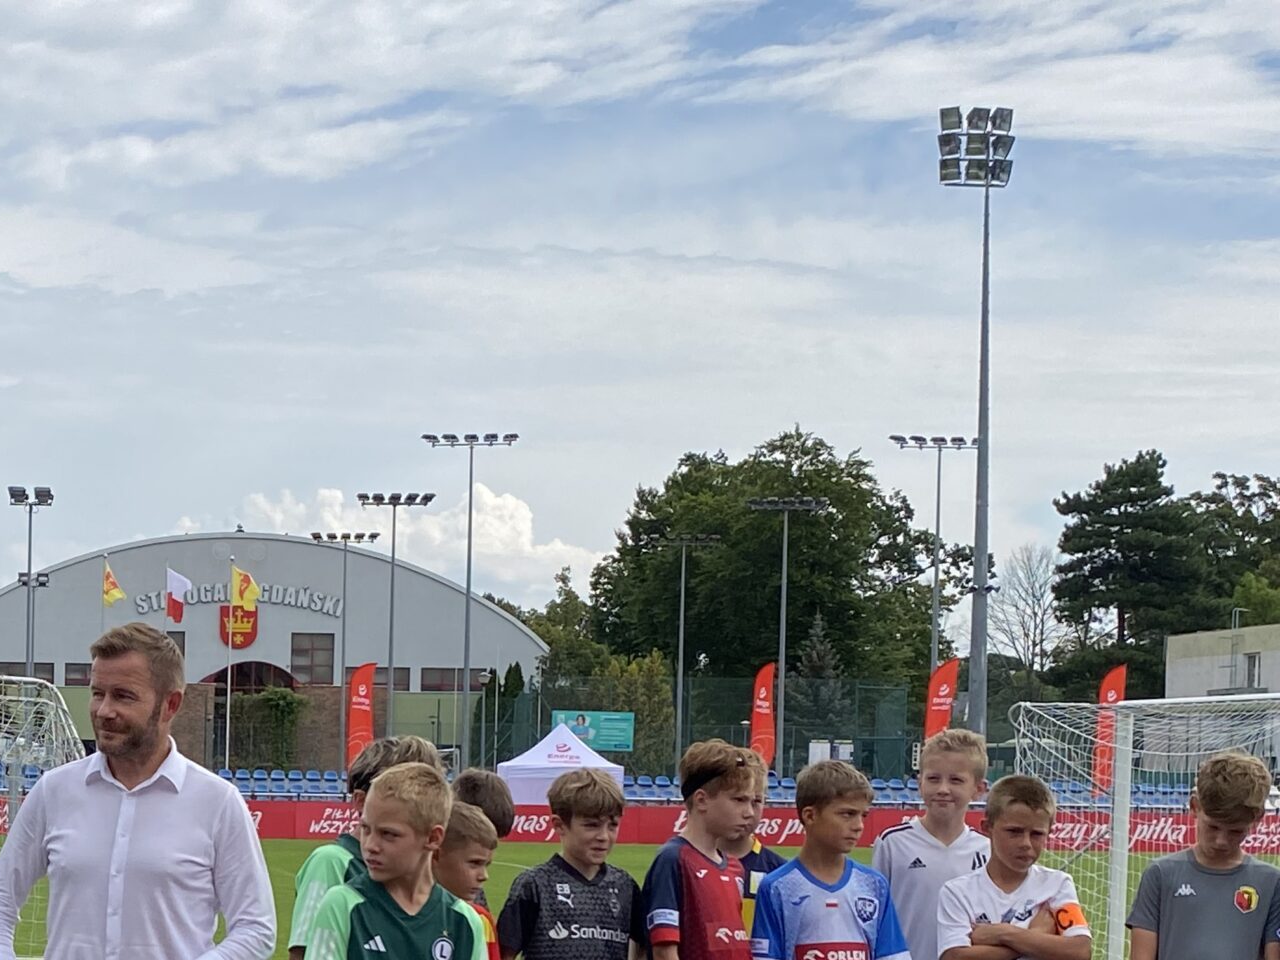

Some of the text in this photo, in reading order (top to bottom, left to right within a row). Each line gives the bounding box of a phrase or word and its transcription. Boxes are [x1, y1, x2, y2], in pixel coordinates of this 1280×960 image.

[257, 582, 343, 618] GDAŃSKI
[1056, 908, 1074, 930] C
[570, 924, 629, 943] Santander
